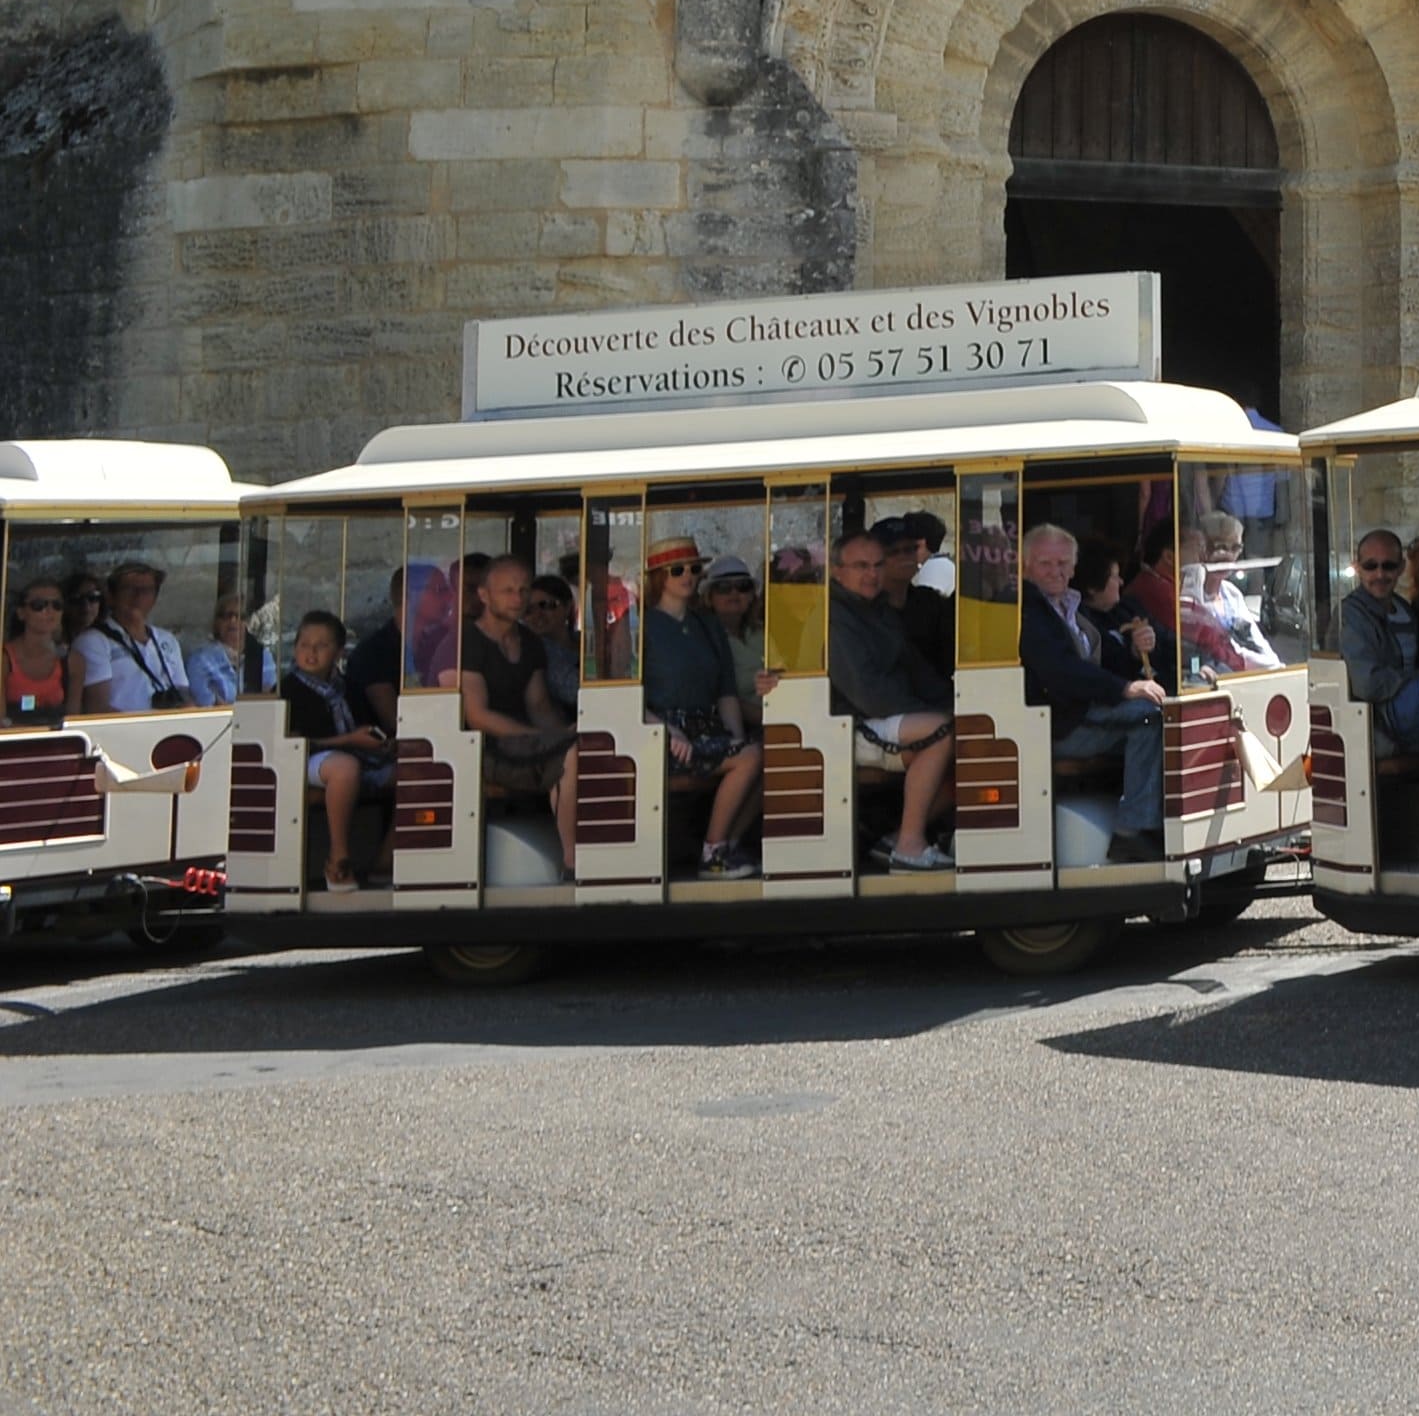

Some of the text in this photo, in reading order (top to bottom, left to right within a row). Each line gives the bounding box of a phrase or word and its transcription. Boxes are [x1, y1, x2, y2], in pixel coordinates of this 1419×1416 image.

[506, 292, 1110, 359] Découverte des Châteaux et des Vignobles
[556, 364, 745, 399] Réservations
[818, 352, 855, 381] 05
[867, 348, 904, 377] 57
[917, 345, 951, 375] 51
[967, 341, 1004, 371] 30
[1017, 338, 1052, 367] 71
